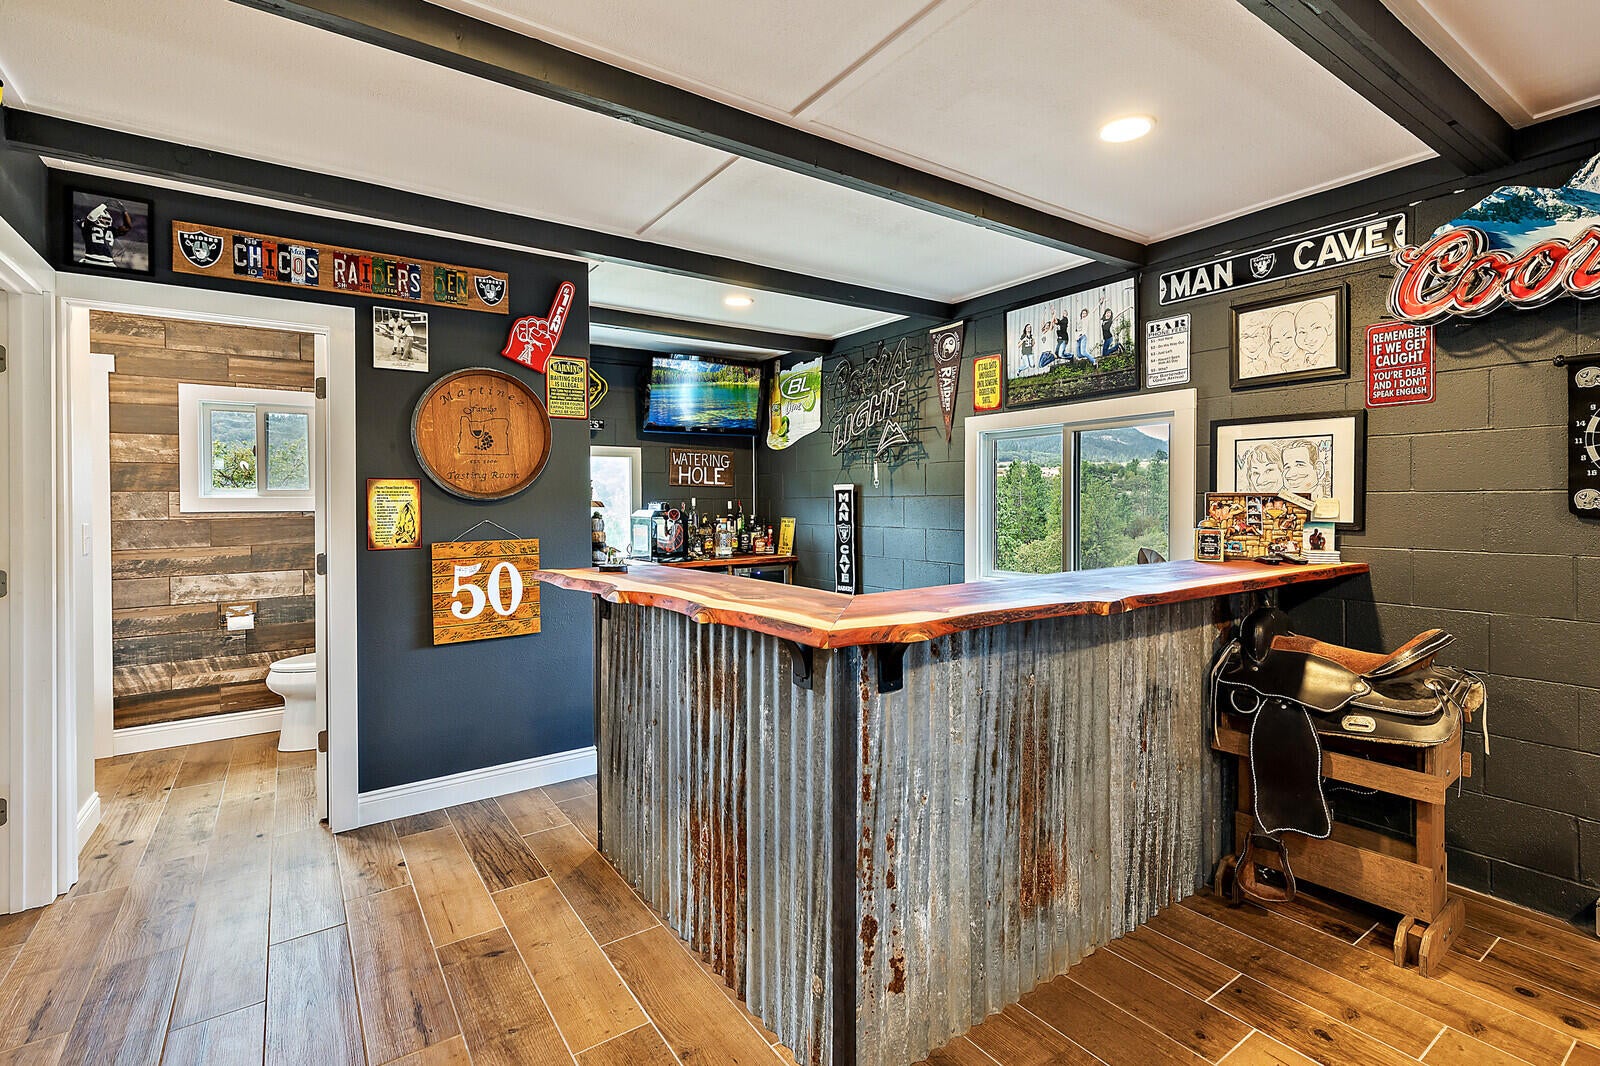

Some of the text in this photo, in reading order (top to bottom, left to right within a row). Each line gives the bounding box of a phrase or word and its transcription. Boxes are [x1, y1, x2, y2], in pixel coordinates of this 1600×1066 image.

[91, 226, 114, 247] 24
[183, 233, 219, 243] RAIDERS
[1170, 221, 1388, 299] MAN CAVE
[234, 243, 467, 297] CHICOS RAIDERS DEN
[550, 306, 565, 332] FAN
[1150, 319, 1186, 332] BAR
[1372, 325, 1427, 344] REMEMBER
[1372, 337, 1427, 355] IF WE GET
[552, 362, 582, 373] WARNING
[1375, 350, 1424, 367] CAUGHT
[1373, 366, 1427, 381] YOU'RE DEAF
[1373, 376, 1427, 390] AND I DON'T
[788, 376, 811, 395] BL
[1372, 386, 1427, 399] SPEAK ENGLISH
[440, 386, 525, 406] Martinez
[831, 380, 907, 456] LIGHT
[672, 452, 731, 469] WATERING
[446, 470, 520, 482] Tasting Room
[678, 466, 726, 485] HOLE
[838, 492, 850, 522] MAN
[839, 544, 851, 583] CAVE
[450, 561, 524, 620] 50
